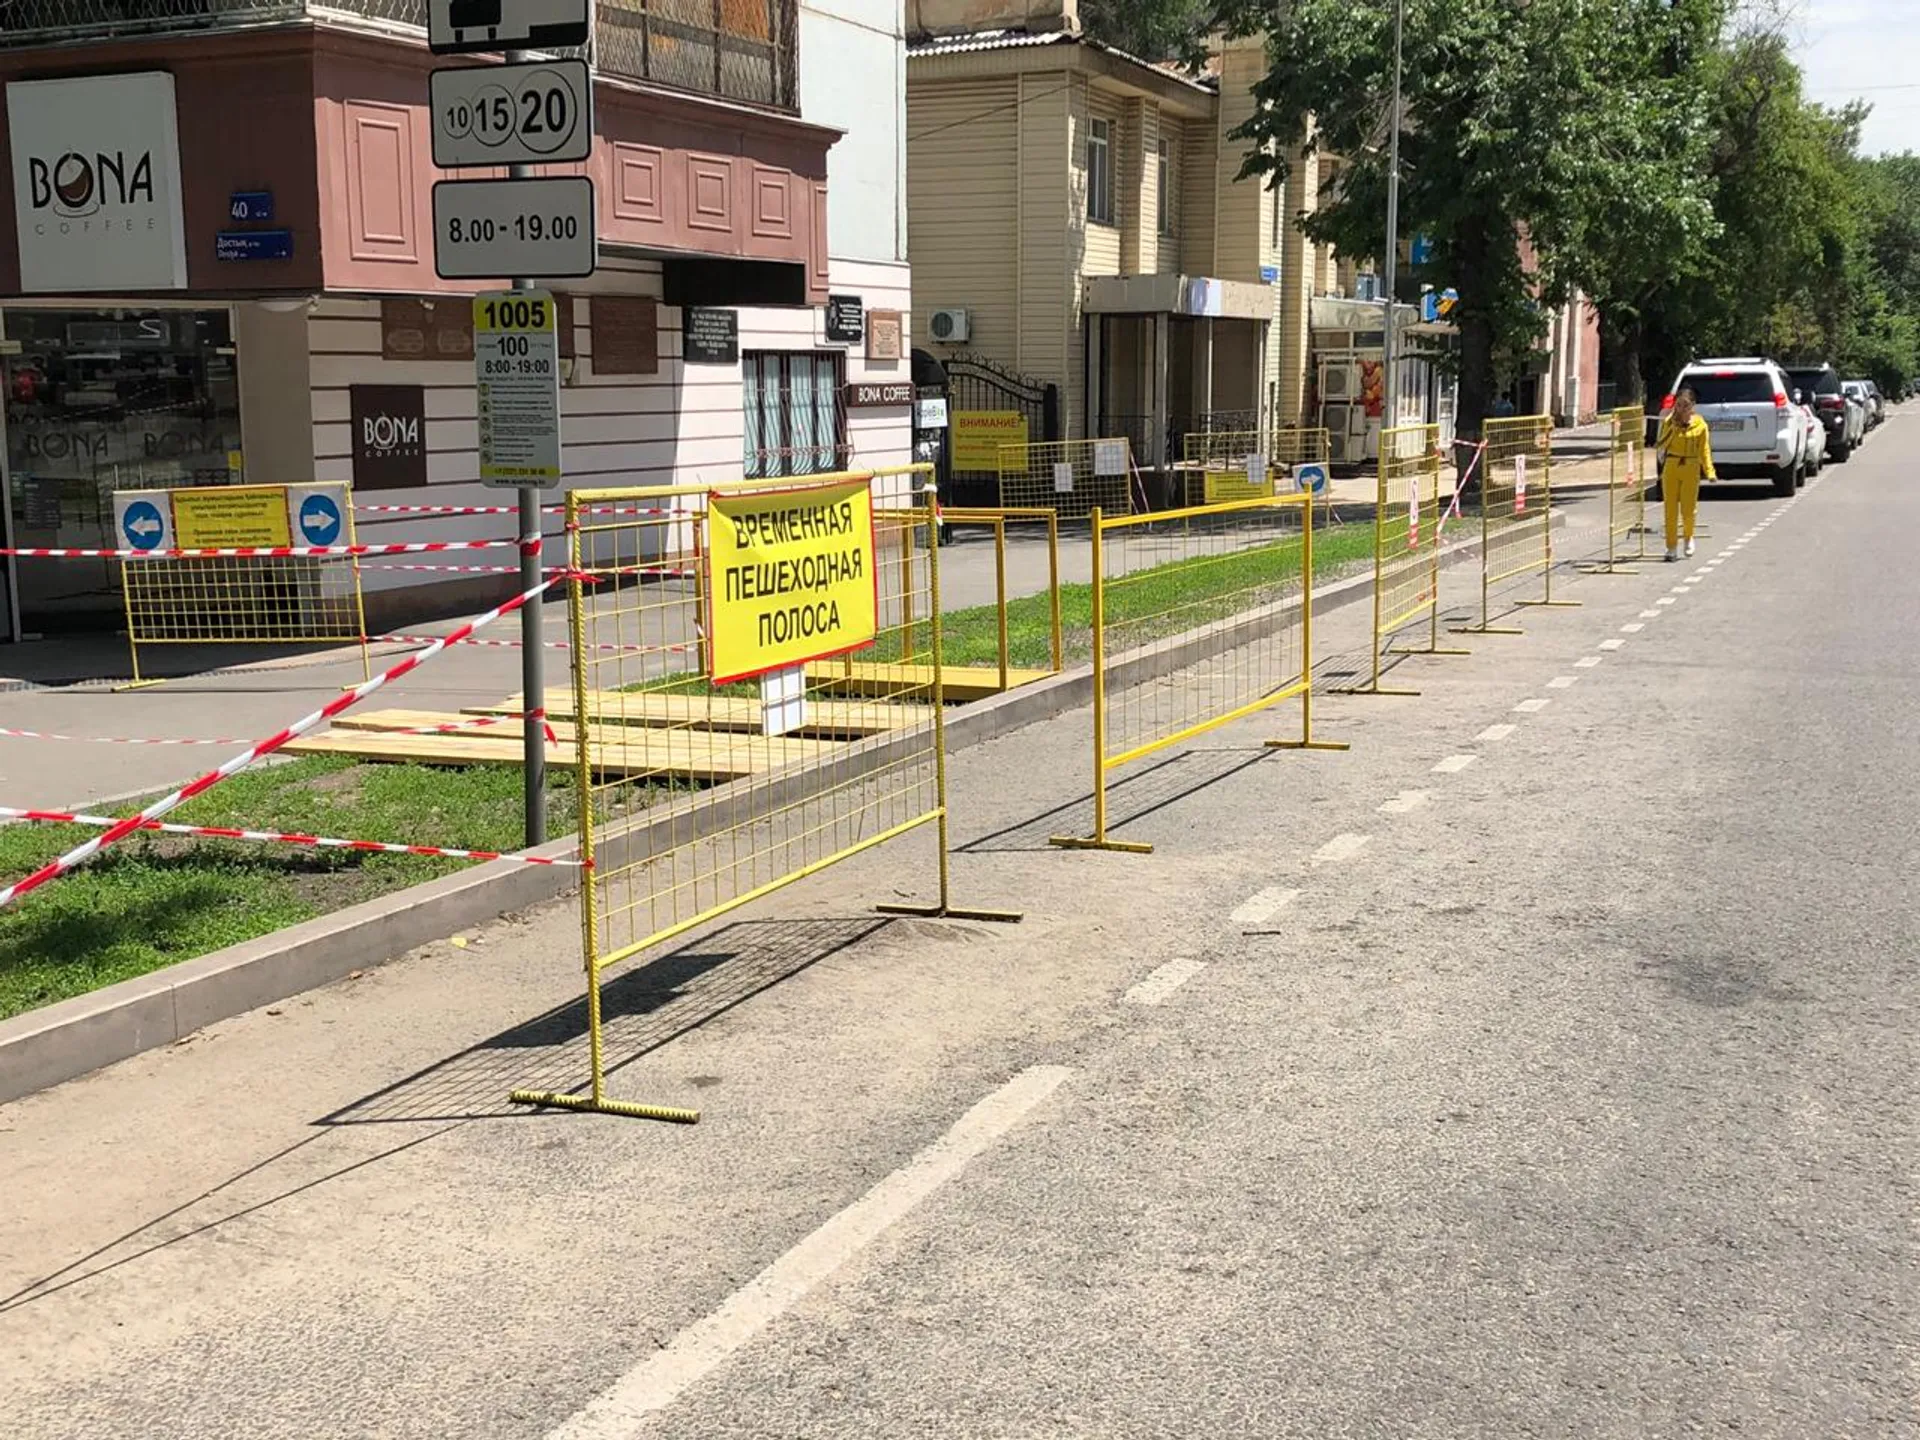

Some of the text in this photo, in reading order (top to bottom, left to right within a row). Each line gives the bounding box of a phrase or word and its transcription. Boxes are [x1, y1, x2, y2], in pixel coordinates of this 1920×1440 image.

[447, 87, 567, 134] 10 15 20
[28, 150, 154, 209] BONA
[231, 200, 249, 218] 40
[33, 217, 156, 236] COFFEE
[484, 300, 546, 329] 1005
[496, 335, 530, 357] 100
[858, 385, 911, 402] BONA COFFEE
[363, 415, 419, 446] BONA
[364, 448, 420, 458] COFFEE
[731, 502, 854, 550] ВРЕМЕННАЯ
[725, 548, 864, 603] ПЕШЕХОДНАЯ
[758, 600, 841, 648] ПОЛОСА
